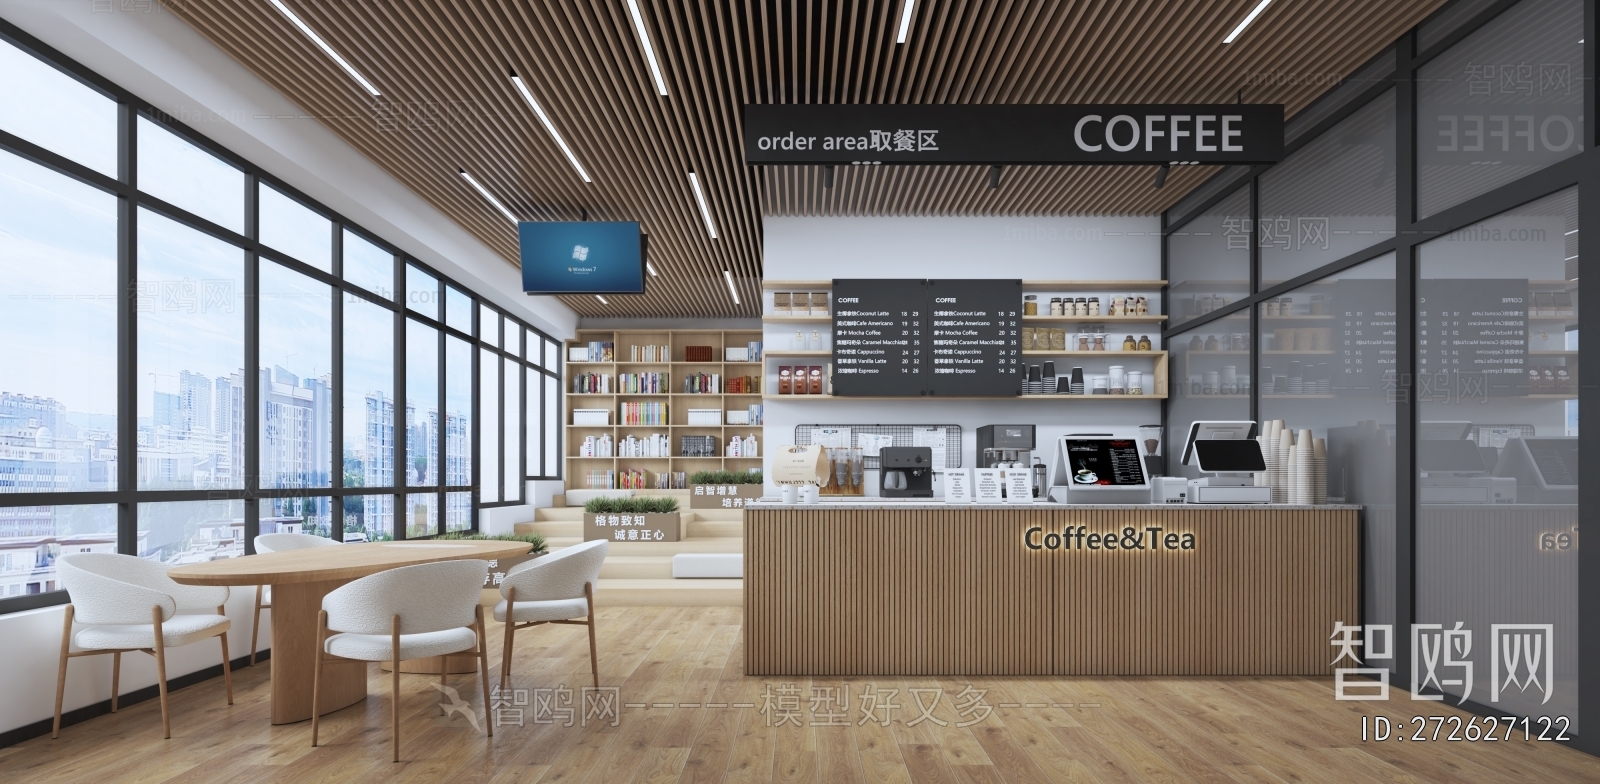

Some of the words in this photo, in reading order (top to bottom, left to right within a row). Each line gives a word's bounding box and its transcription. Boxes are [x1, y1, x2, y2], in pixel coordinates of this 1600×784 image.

[757, 133, 816, 153] order
[822, 128, 939, 154] area取餐区
[1073, 114, 1244, 153] COFFEE
[694, 486, 738, 496] 启智增慧
[595, 515, 646, 527] 格物致知
[614, 530, 665, 540] 诚意正心
[1024, 526, 1196, 551] Coffee&Tea
